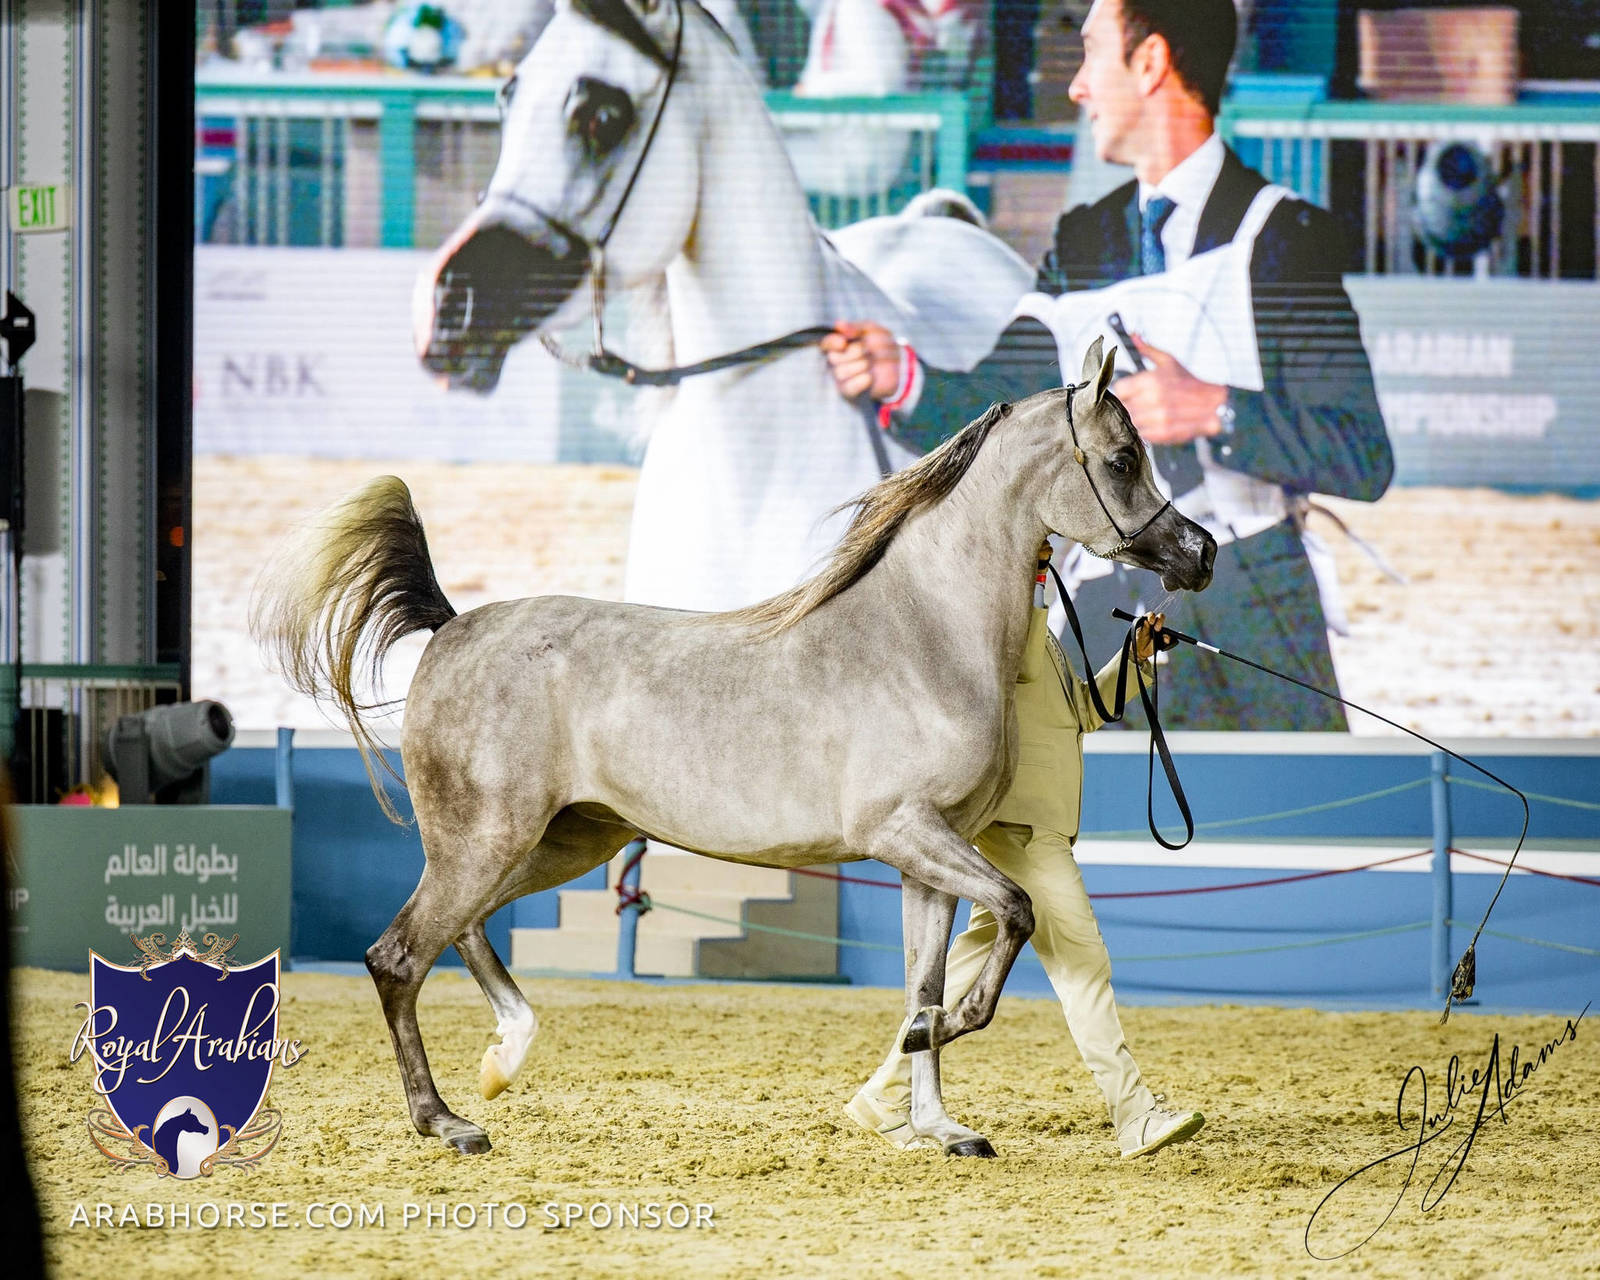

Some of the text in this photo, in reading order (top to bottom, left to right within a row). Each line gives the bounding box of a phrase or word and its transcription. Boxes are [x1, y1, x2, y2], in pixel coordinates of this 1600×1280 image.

[18, 187, 56, 227] EXIT
[220, 352, 328, 397] NBK
[104, 844, 239, 884] بطولة العالم
[104, 894, 175, 933] العربية
